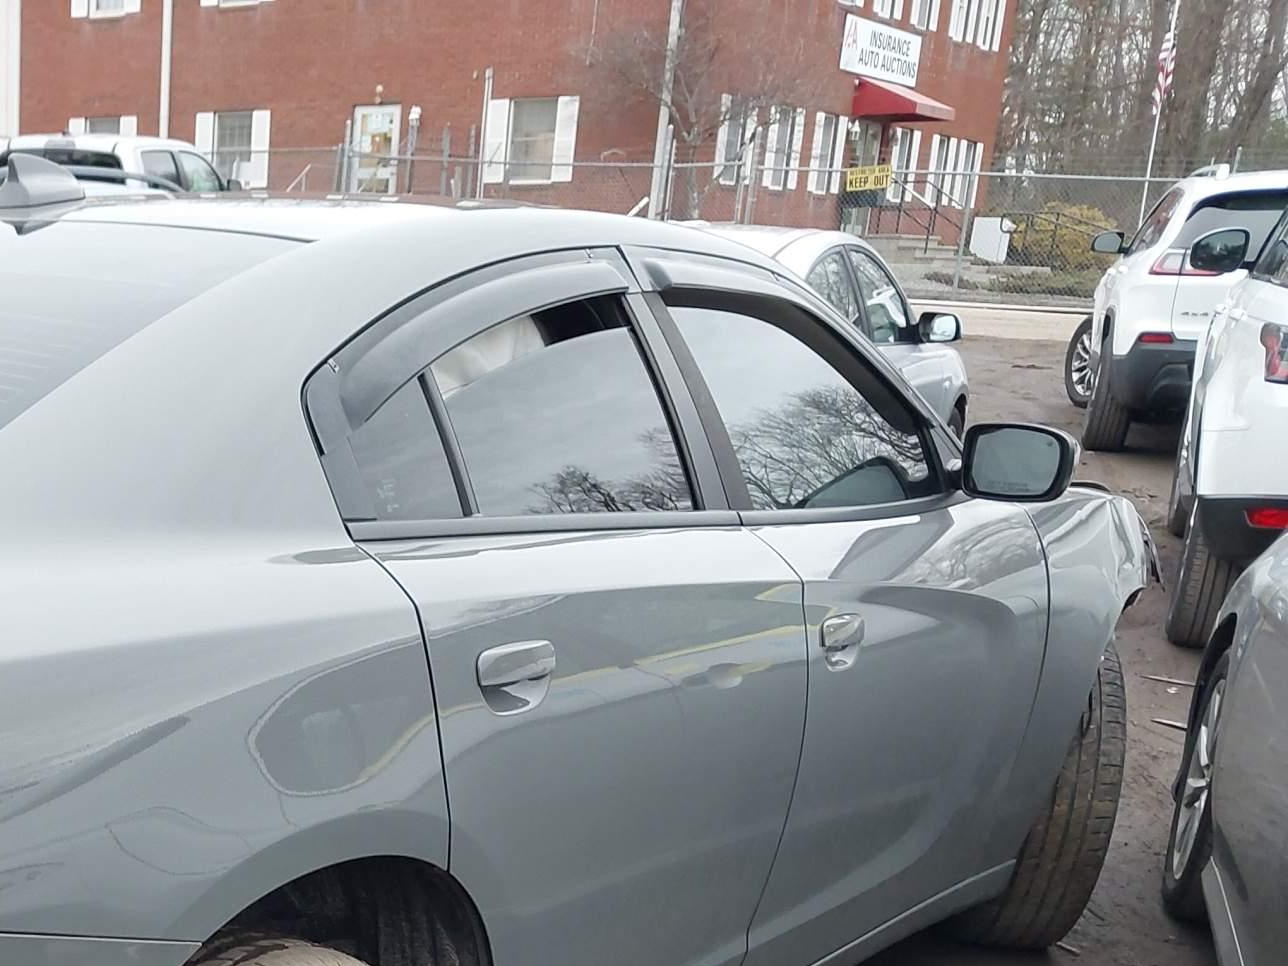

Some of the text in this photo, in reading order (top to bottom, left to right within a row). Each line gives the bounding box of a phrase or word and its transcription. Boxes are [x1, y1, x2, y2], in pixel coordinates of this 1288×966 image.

[869, 30, 911, 57] INSURANCE
[858, 47, 917, 79] AUTO AUCTIONS
[849, 174, 890, 189] KEEP OUT
